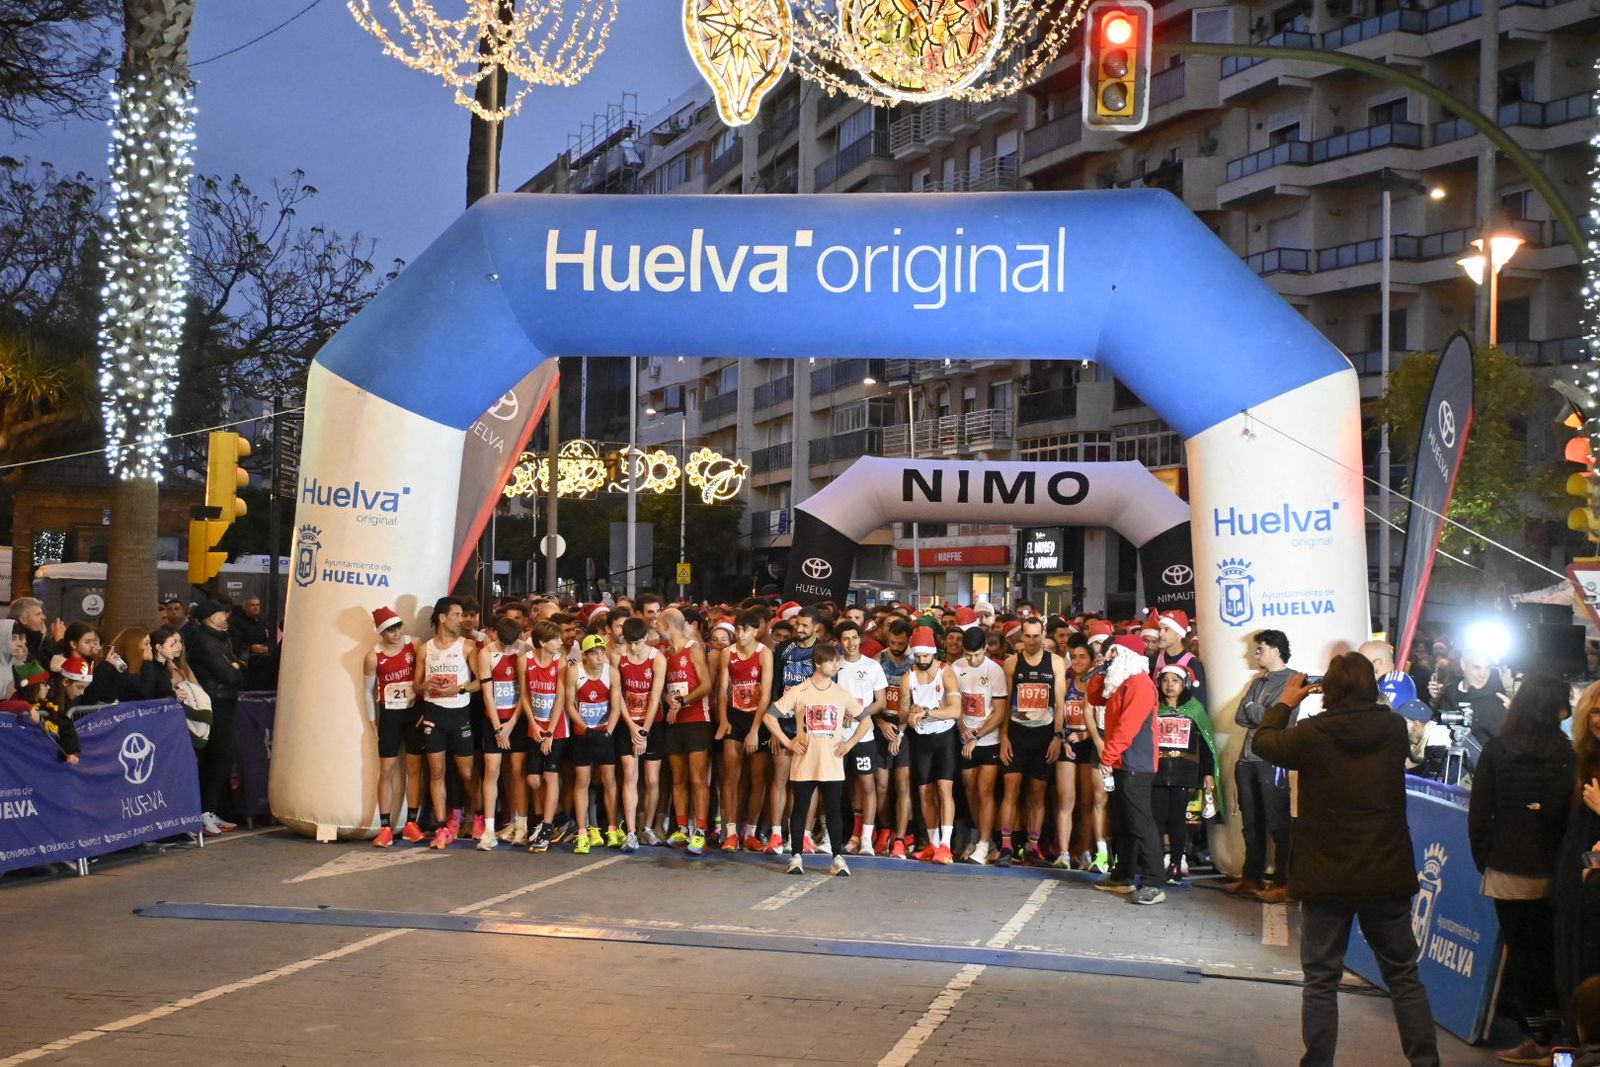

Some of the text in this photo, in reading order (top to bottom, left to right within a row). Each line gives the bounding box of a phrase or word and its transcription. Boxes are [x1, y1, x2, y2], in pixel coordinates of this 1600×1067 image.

[545, 227, 1065, 310] Huelva original
[469, 420, 504, 454] ELVA
[1428, 427, 1449, 484] HUELVA
[302, 477, 400, 512] Huelva
[902, 468, 1090, 506] NIMO
[356, 514, 398, 526] original
[1214, 503, 1331, 536] Huelva
[1291, 535, 1333, 549] original
[938, 551, 962, 562] MAPFRE
[324, 559, 392, 572] Ayuntamiento de
[322, 568, 390, 588] HUELVA
[795, 583, 832, 597] HUELVA
[1261, 588, 1336, 600] Ayuntamiento de
[1262, 600, 1336, 616] HUELVA
[394, 689, 407, 699] 21
[1020, 688, 1048, 699] 1979
[856, 756, 872, 772] 23
[1428, 933, 1475, 978] HUELVA
